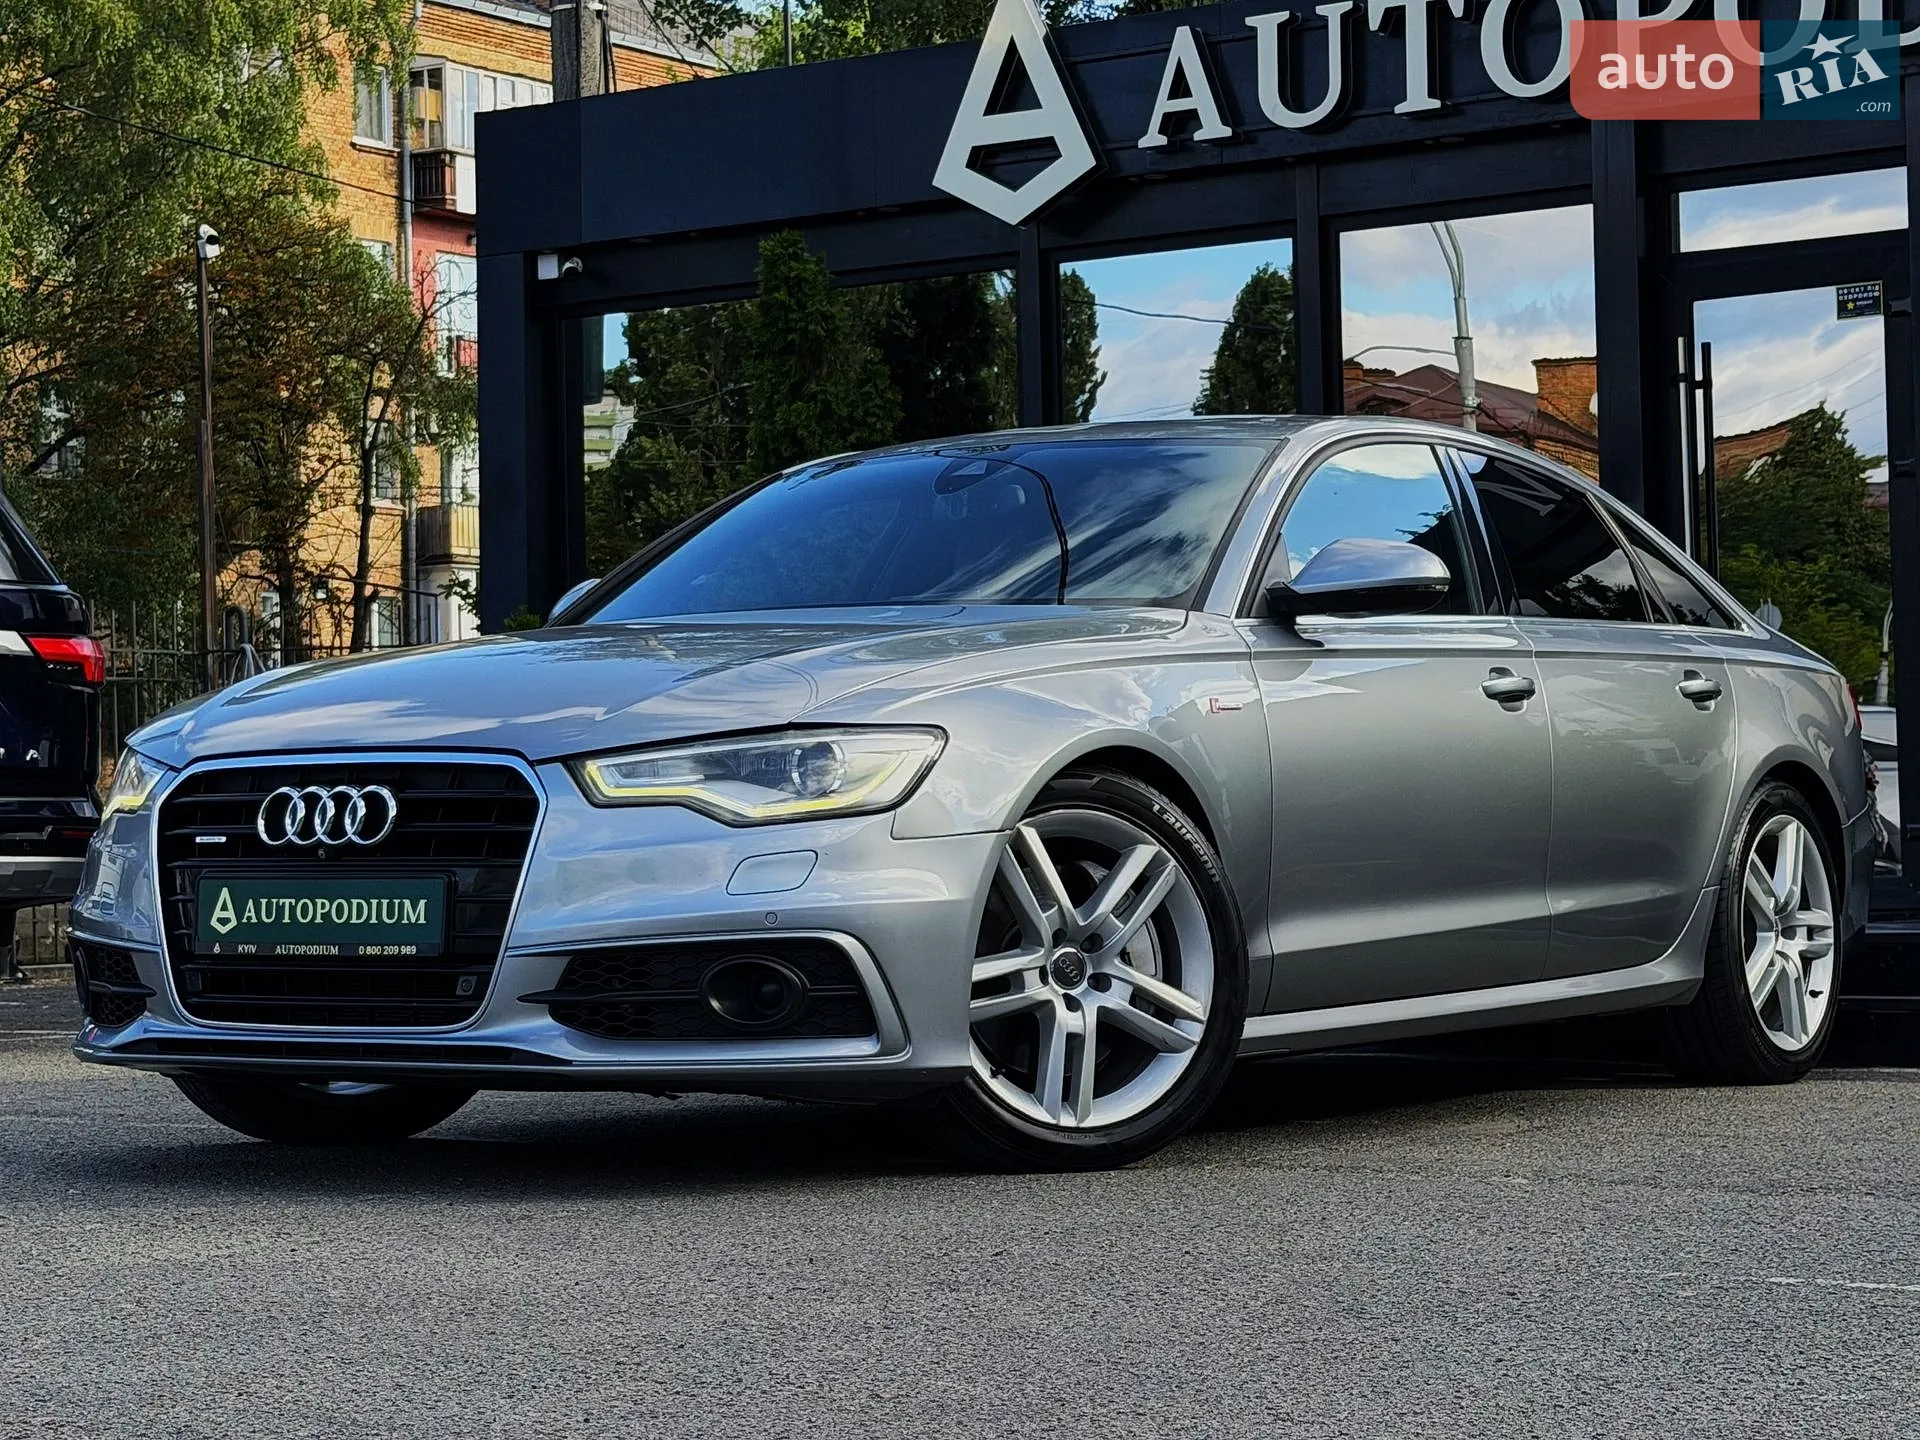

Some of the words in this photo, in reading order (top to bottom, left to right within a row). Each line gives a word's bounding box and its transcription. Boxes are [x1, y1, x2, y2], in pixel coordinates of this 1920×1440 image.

[241, 898, 428, 924] AUTOPODIUM
[238, 944, 257, 954] KYIV
[275, 945, 339, 955] AUTOPODIUM
[358, 945, 365, 955] 0
[365, 945, 381, 955] 800
[383, 945, 399, 955] 209
